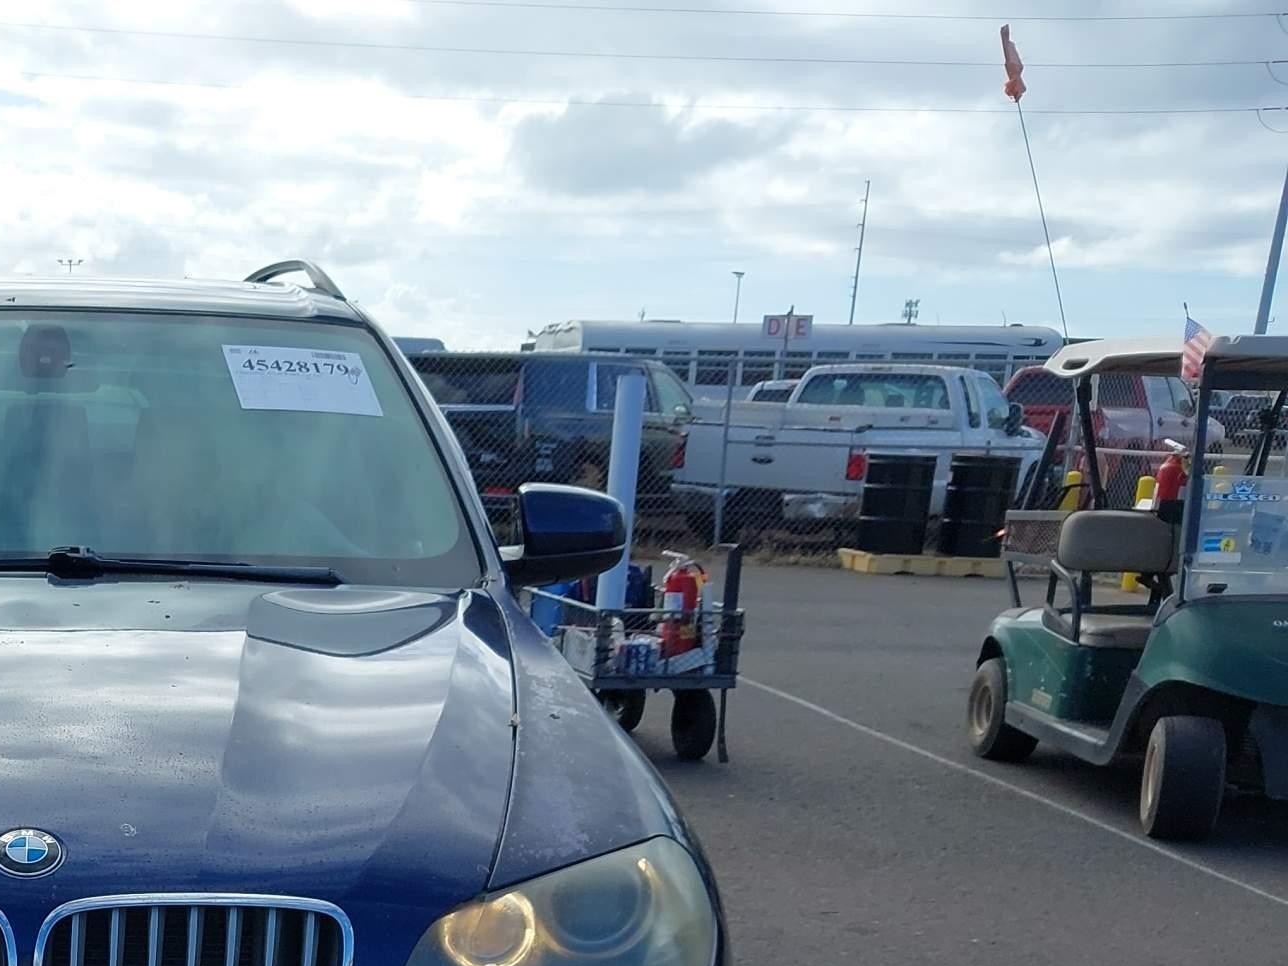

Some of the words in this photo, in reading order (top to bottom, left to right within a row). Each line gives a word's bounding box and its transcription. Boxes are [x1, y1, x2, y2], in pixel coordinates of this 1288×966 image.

[241, 358, 350, 376] 45428179
[1206, 493, 1281, 502] BLESSED
[0, 829, 57, 844] BMW
